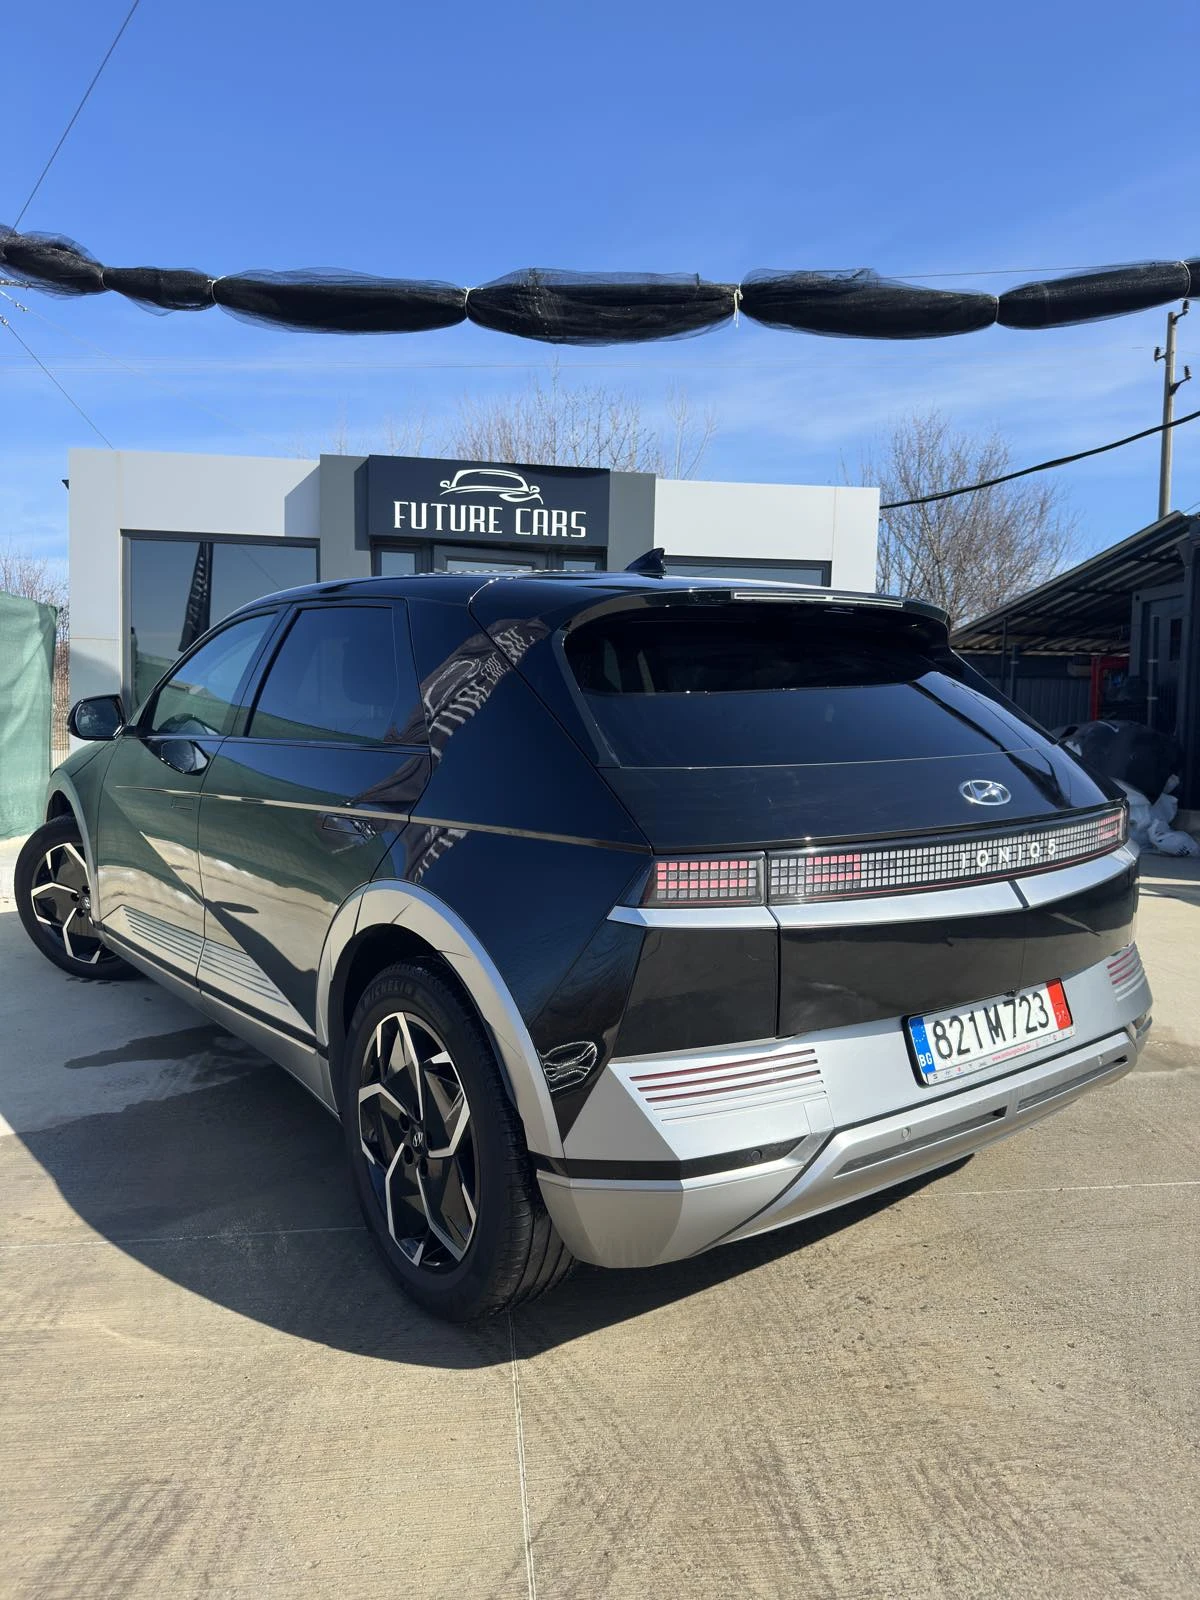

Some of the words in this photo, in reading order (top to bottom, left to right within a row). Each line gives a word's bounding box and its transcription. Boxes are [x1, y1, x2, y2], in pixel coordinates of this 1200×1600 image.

[393, 500, 503, 534] FUTURE
[515, 508, 587, 538] CARS
[918, 1052, 934, 1067] BG
